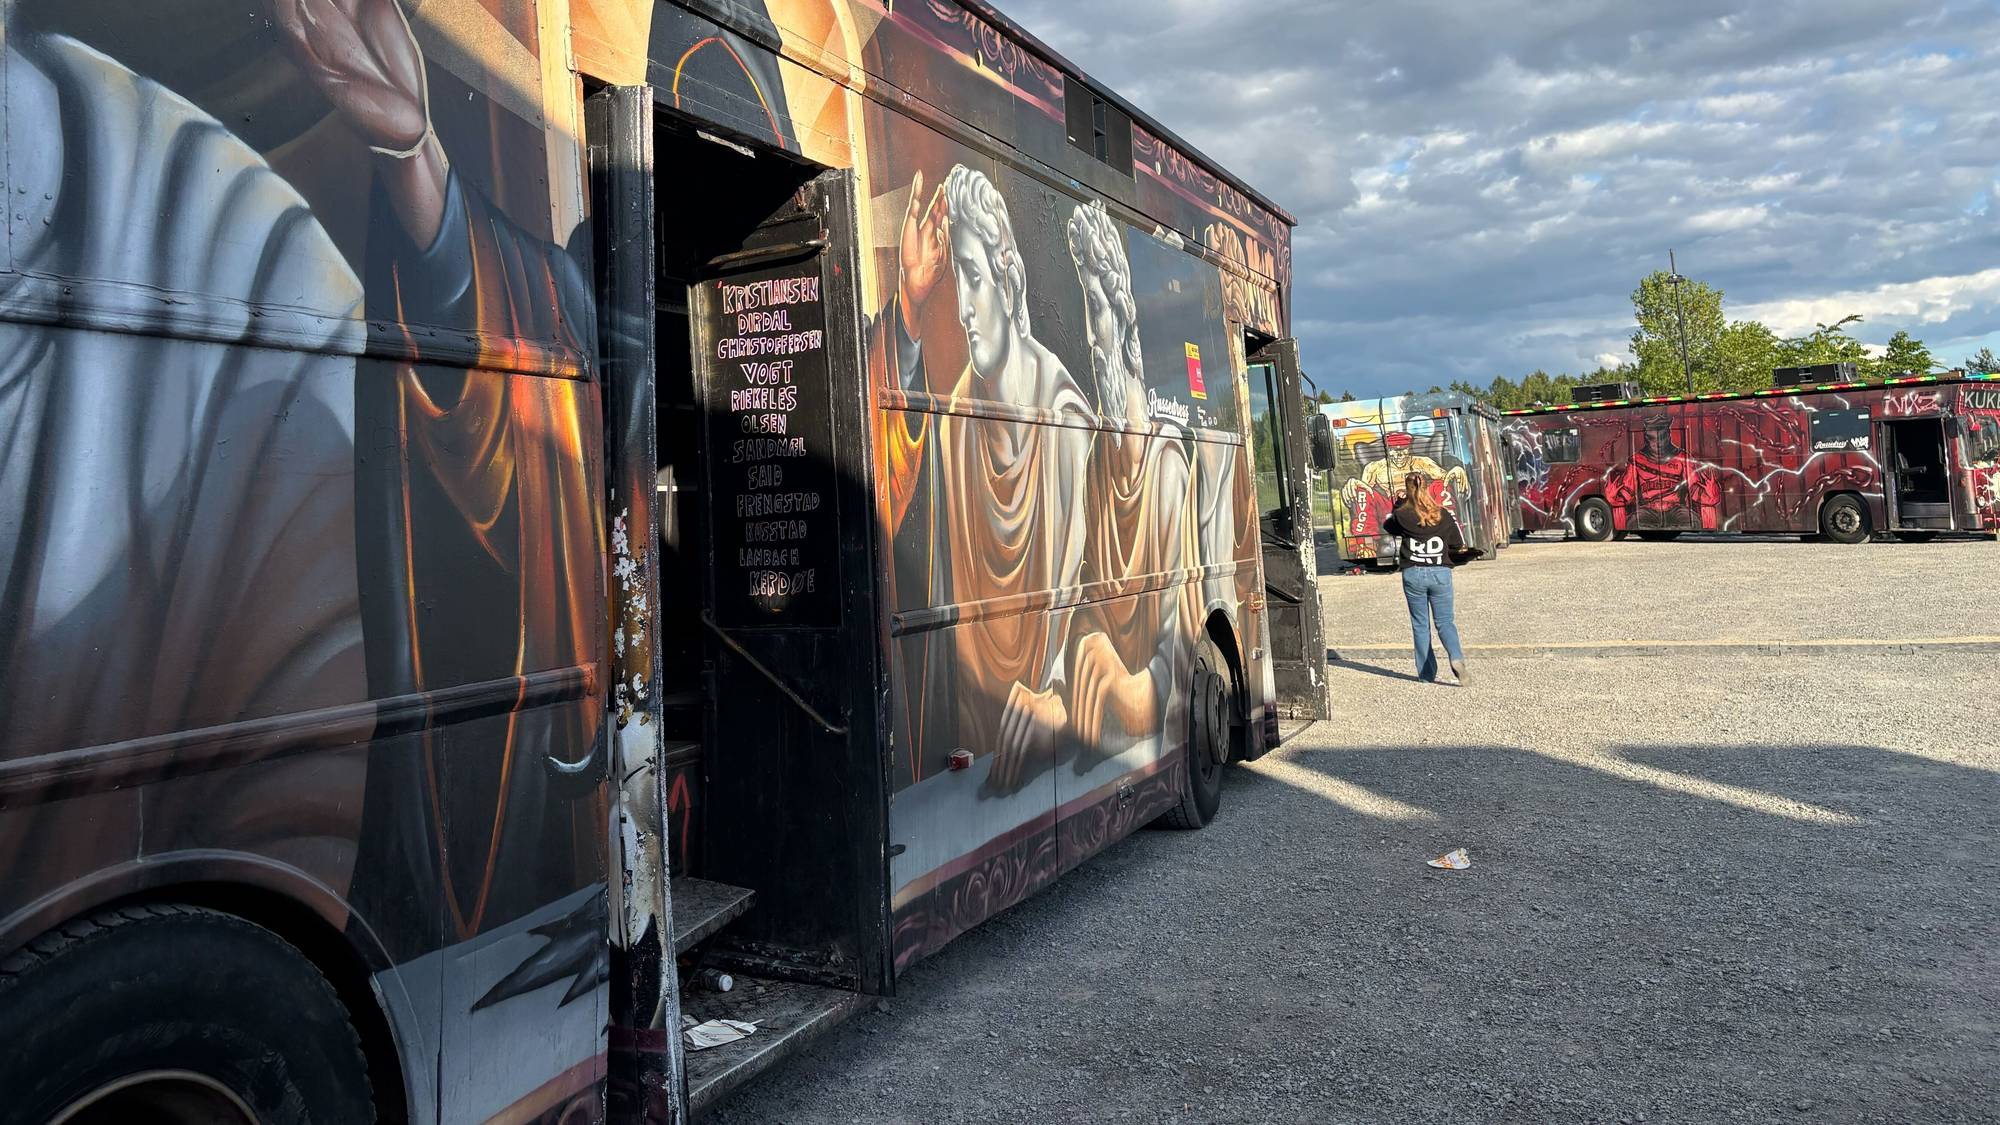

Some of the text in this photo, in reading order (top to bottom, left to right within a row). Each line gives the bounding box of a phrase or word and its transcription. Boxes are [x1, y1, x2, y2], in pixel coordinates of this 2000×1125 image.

[722, 276, 819, 314] KRISTIANSEN
[738, 309, 791, 335] DIRDAL
[717, 330, 823, 359] CHRISTOFFERSEN
[740, 360, 793, 385] VOGT
[731, 386, 797, 412] RIEKELES
[741, 413, 787, 435] OLSEN
[748, 464, 783, 489] SAID
[736, 492, 821, 517] FRENGSTAD
